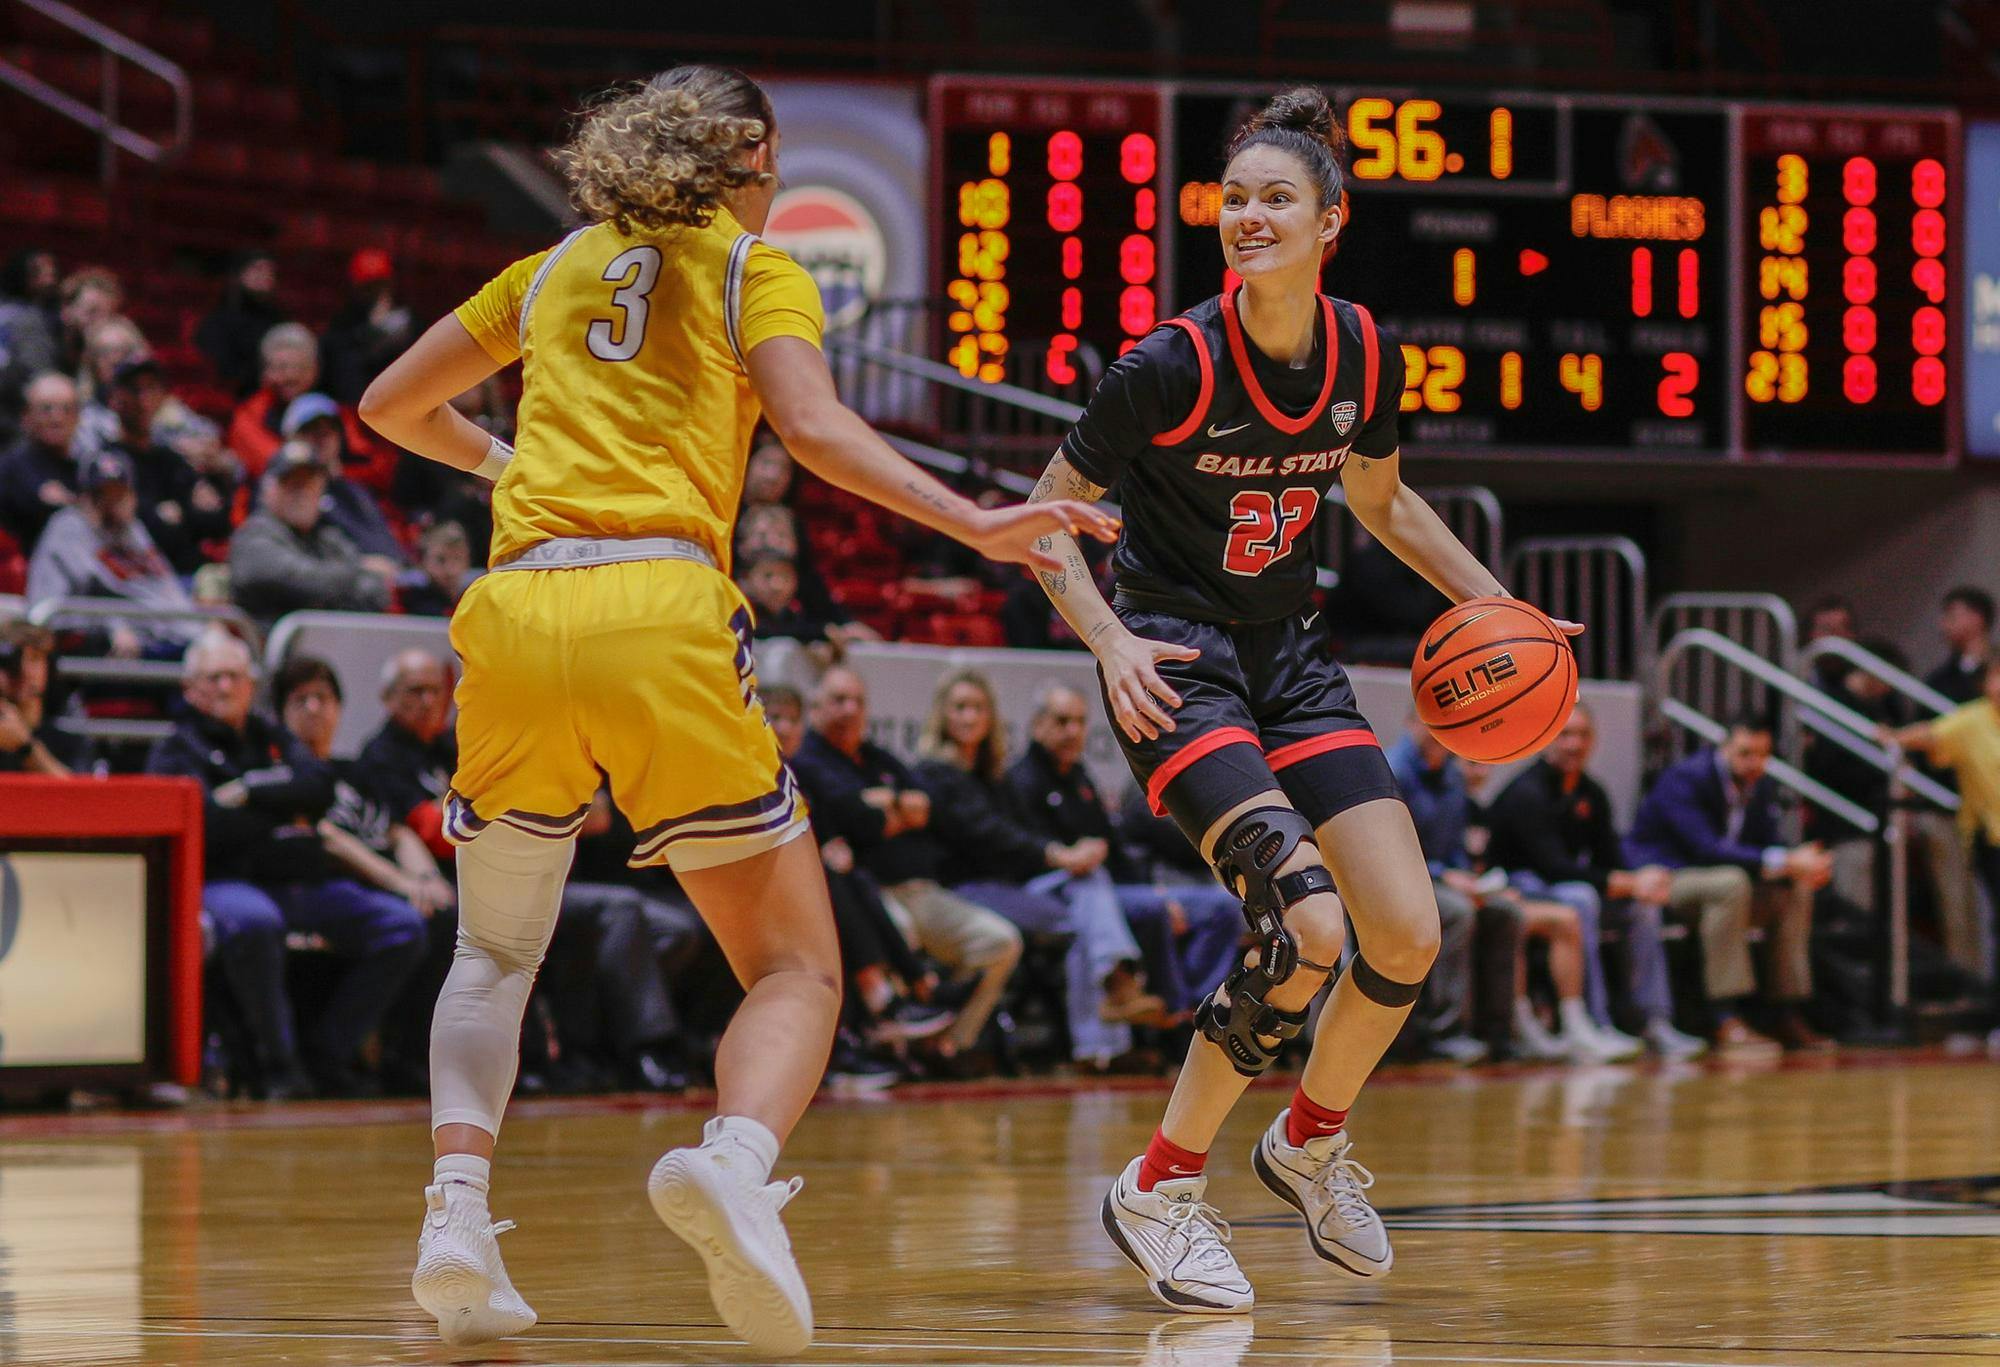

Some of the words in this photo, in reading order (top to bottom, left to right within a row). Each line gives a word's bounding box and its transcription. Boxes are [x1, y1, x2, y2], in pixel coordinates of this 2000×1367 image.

[988, 131, 1011, 177] 1
[1776, 154, 1809, 204] 3
[1135, 187, 1156, 230] 1
[1062, 236, 1083, 280] 1
[1453, 248, 1476, 306] 1
[585, 245, 662, 362] 3
[1061, 286, 1082, 330] 1
[1500, 351, 1522, 410] 1
[1559, 353, 1603, 411] 4
[1657, 352, 1699, 418] 2
[1194, 453, 1275, 478] BALL
[1222, 486, 1321, 577] 22
[1431, 651, 1518, 709] ELITE
